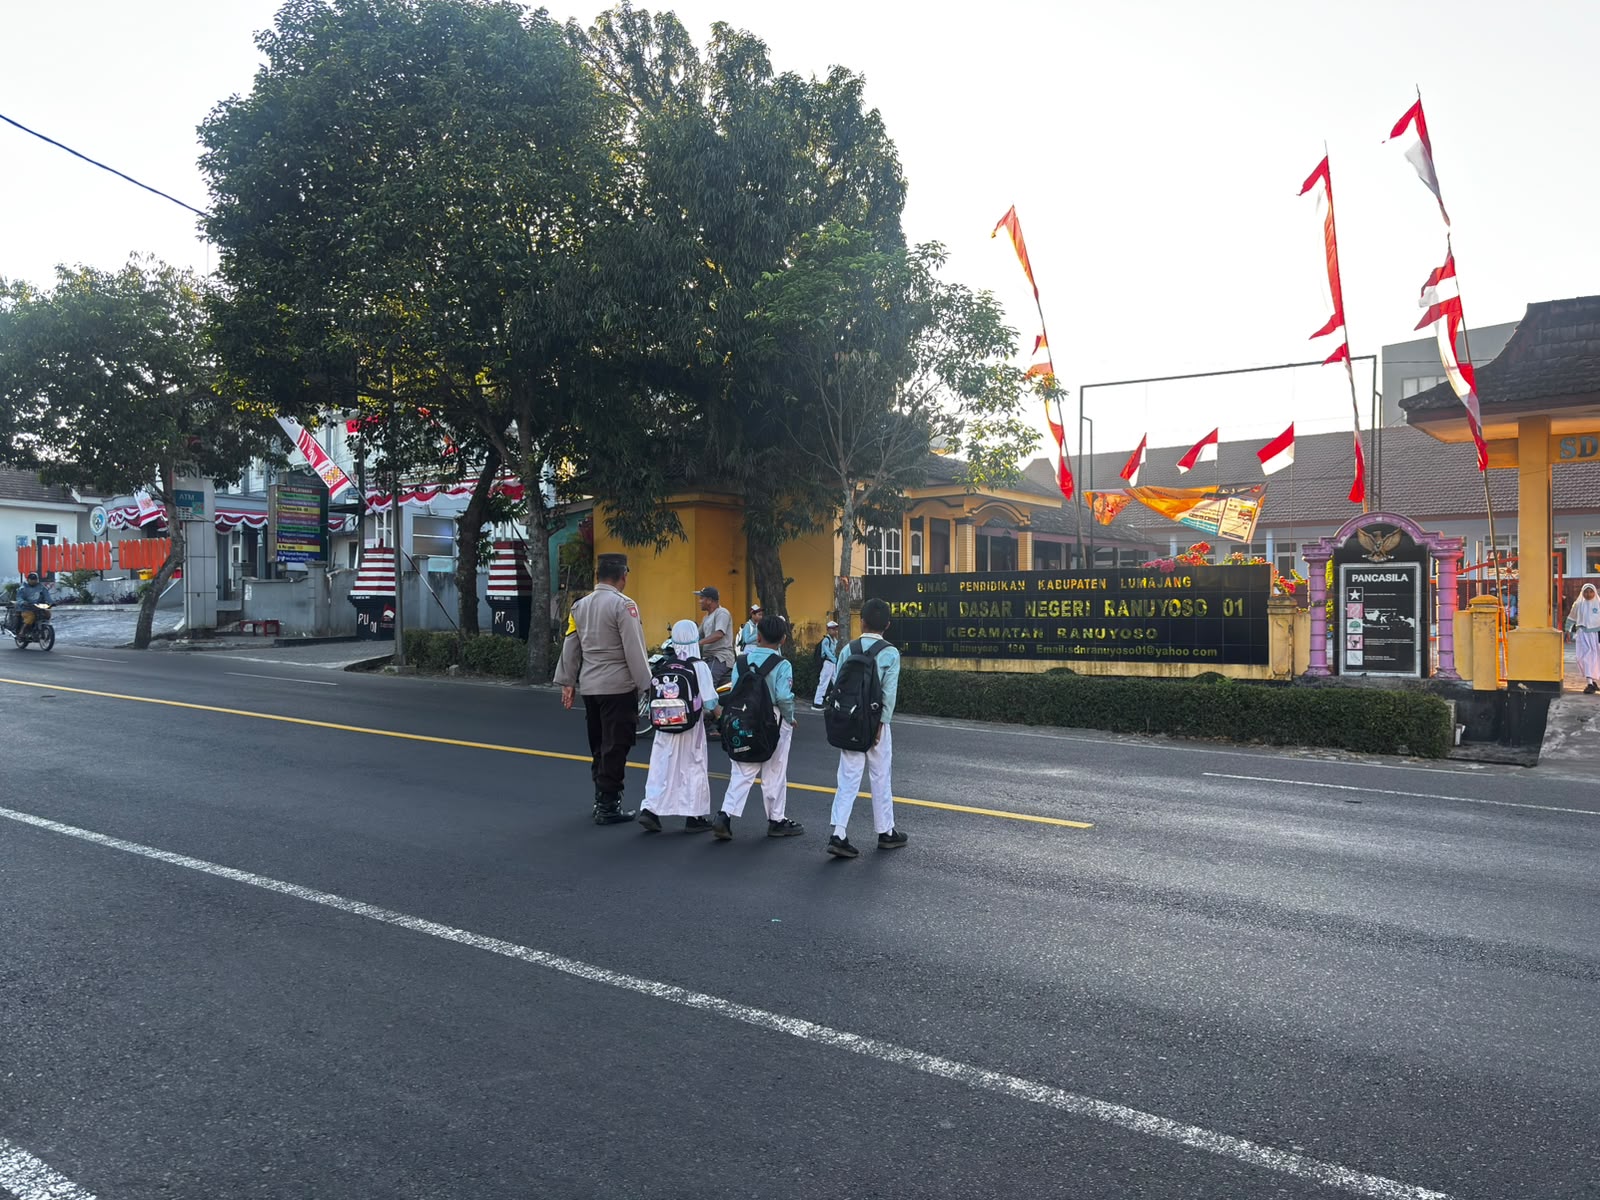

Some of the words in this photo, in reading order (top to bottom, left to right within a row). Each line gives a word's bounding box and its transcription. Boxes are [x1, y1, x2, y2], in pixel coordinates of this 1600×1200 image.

[1560, 436, 1598, 459] SD
[179, 493, 195, 501] ATM
[959, 579, 1026, 592] PENDIDIKAN
[1037, 577, 1107, 591] KABUPATEN
[1120, 575, 1192, 589] LUMAJANG
[1351, 573, 1409, 583] PANCASILA
[886, 601, 948, 618] EKOLAH
[959, 600, 1013, 618] DASAR
[1024, 599, 1091, 617] NEGERI
[1104, 598, 1208, 617] RANUYOSO
[1222, 597, 1245, 617] 01
[495, 611, 505, 625] RT
[505, 620, 515, 634] 03
[946, 626, 1044, 640] KECAMATAN
[1056, 626, 1159, 640] RANUYOSO
[952, 643, 1000, 655] Ranuyoso
